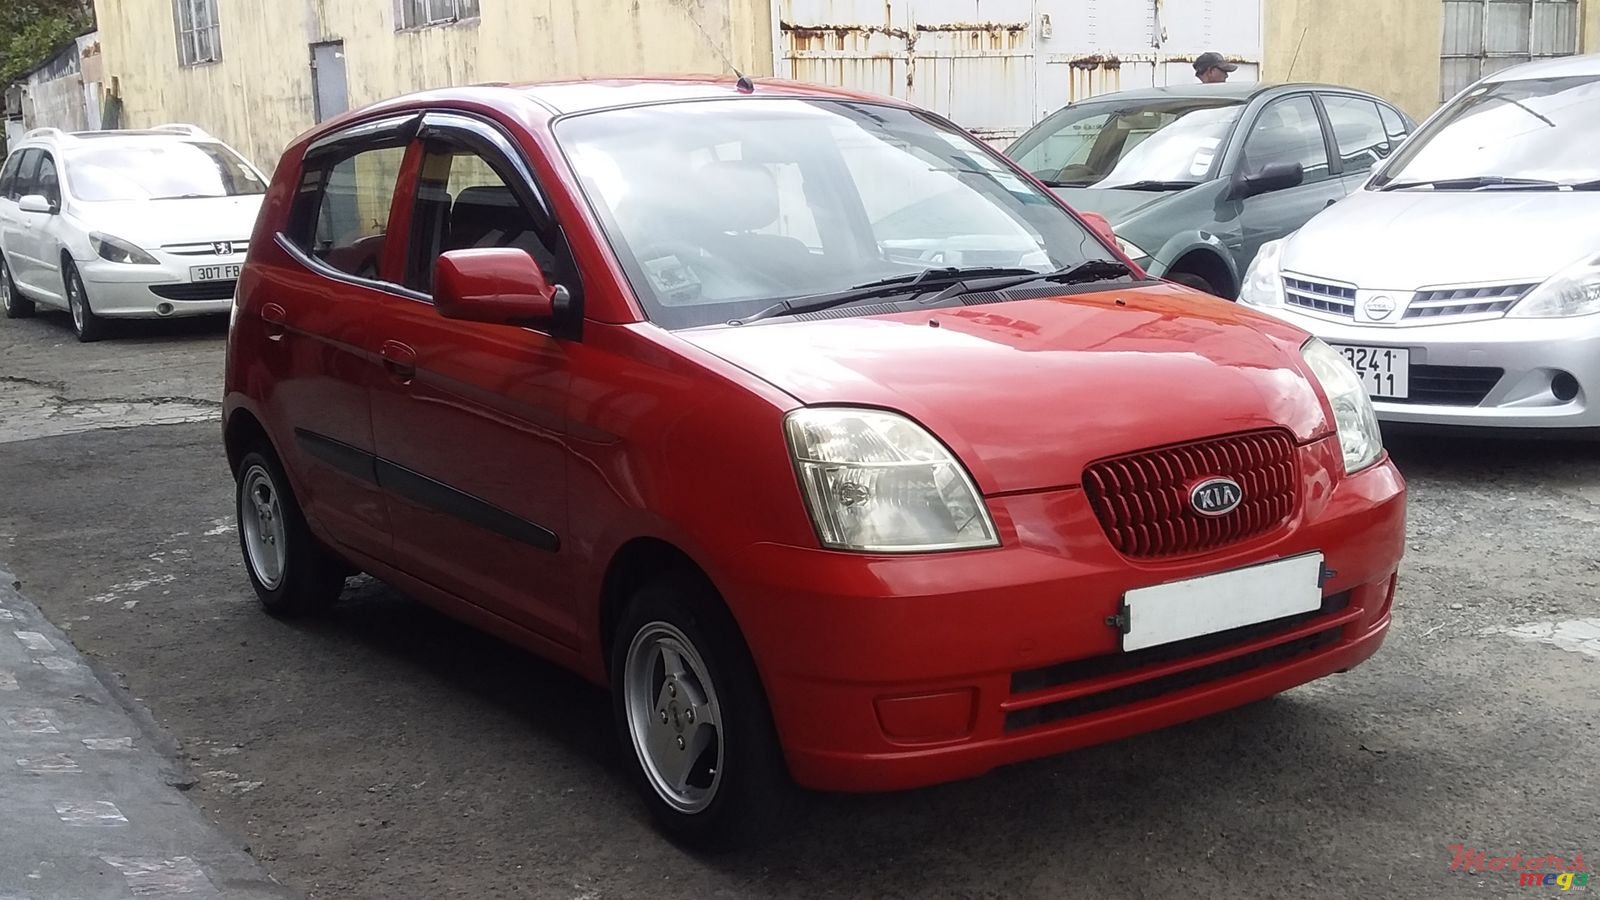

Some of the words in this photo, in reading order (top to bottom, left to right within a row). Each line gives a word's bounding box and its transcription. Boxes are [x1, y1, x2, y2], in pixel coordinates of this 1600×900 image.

[198, 267, 220, 280] 307
[225, 266, 240, 278] FB
[1344, 348, 1391, 373] 3241
[1199, 486, 1236, 509] KIA
